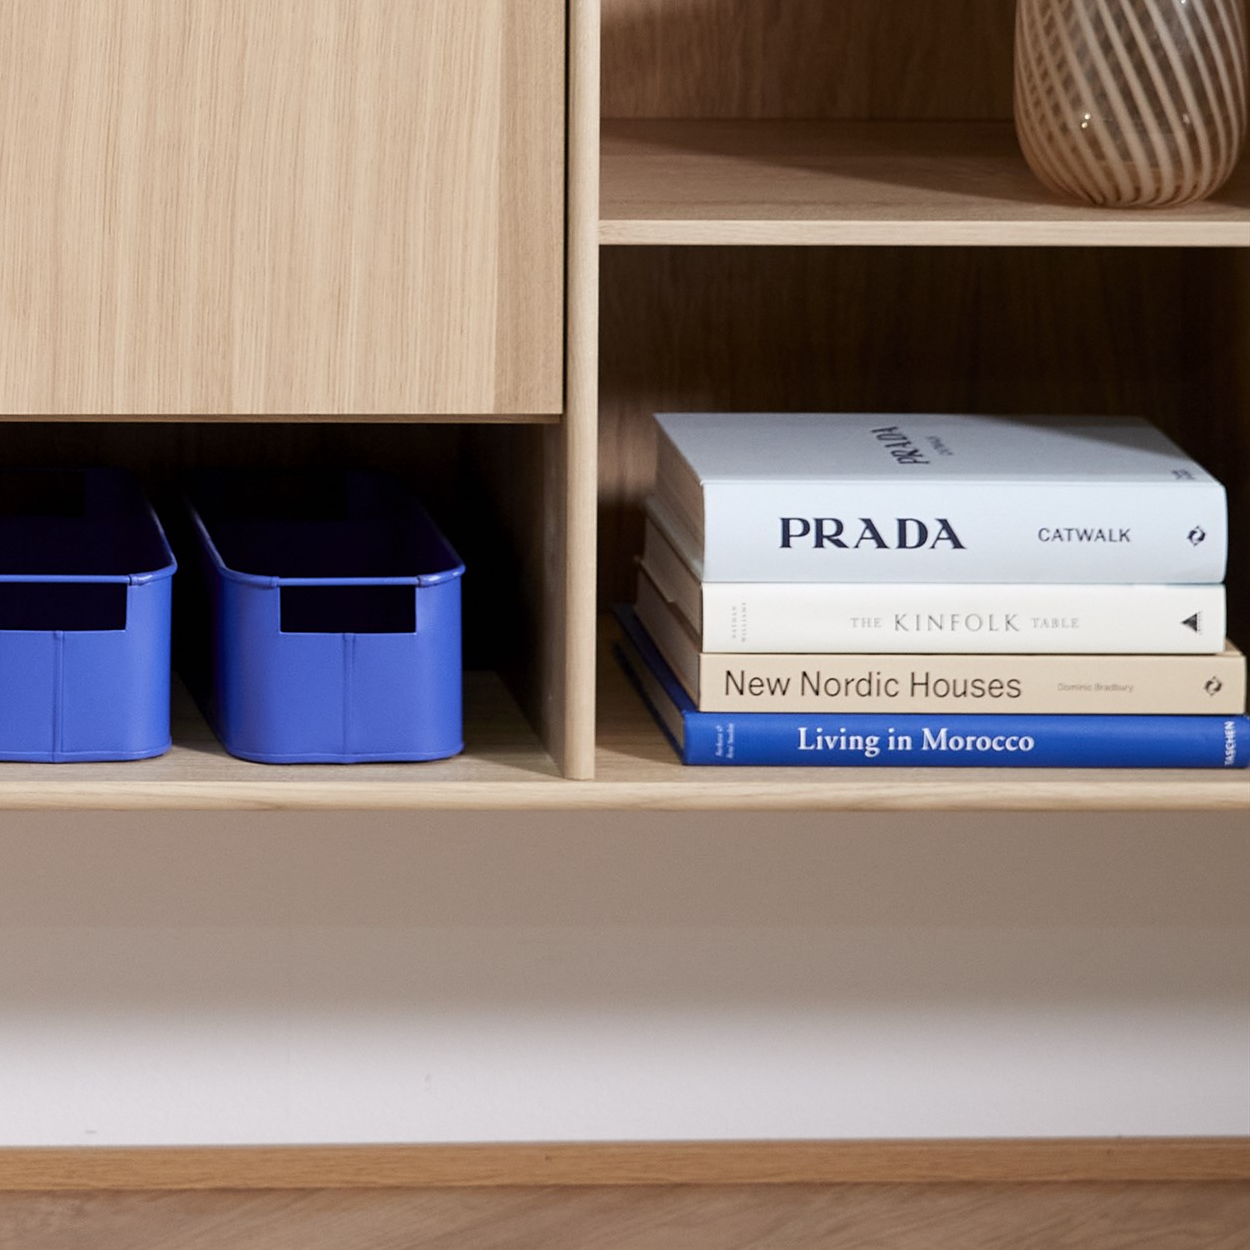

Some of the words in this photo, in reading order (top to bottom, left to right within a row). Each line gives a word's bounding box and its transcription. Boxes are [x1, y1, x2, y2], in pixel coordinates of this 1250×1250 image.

[870, 426, 930, 465] PRADA
[780, 518, 966, 549] PRADA
[1038, 528, 1130, 542] CATWALK
[850, 618, 881, 628] THE
[895, 614, 1019, 631] KINFOLK
[1032, 618, 1078, 628] TABLE
[726, 670, 790, 696] New
[801, 671, 899, 697] Nordic
[911, 672, 1021, 698] Houses
[797, 727, 880, 757] Living
[887, 727, 912, 751] in
[921, 728, 1034, 750] Morocco
[1224, 720, 1236, 766] TASCHEN
